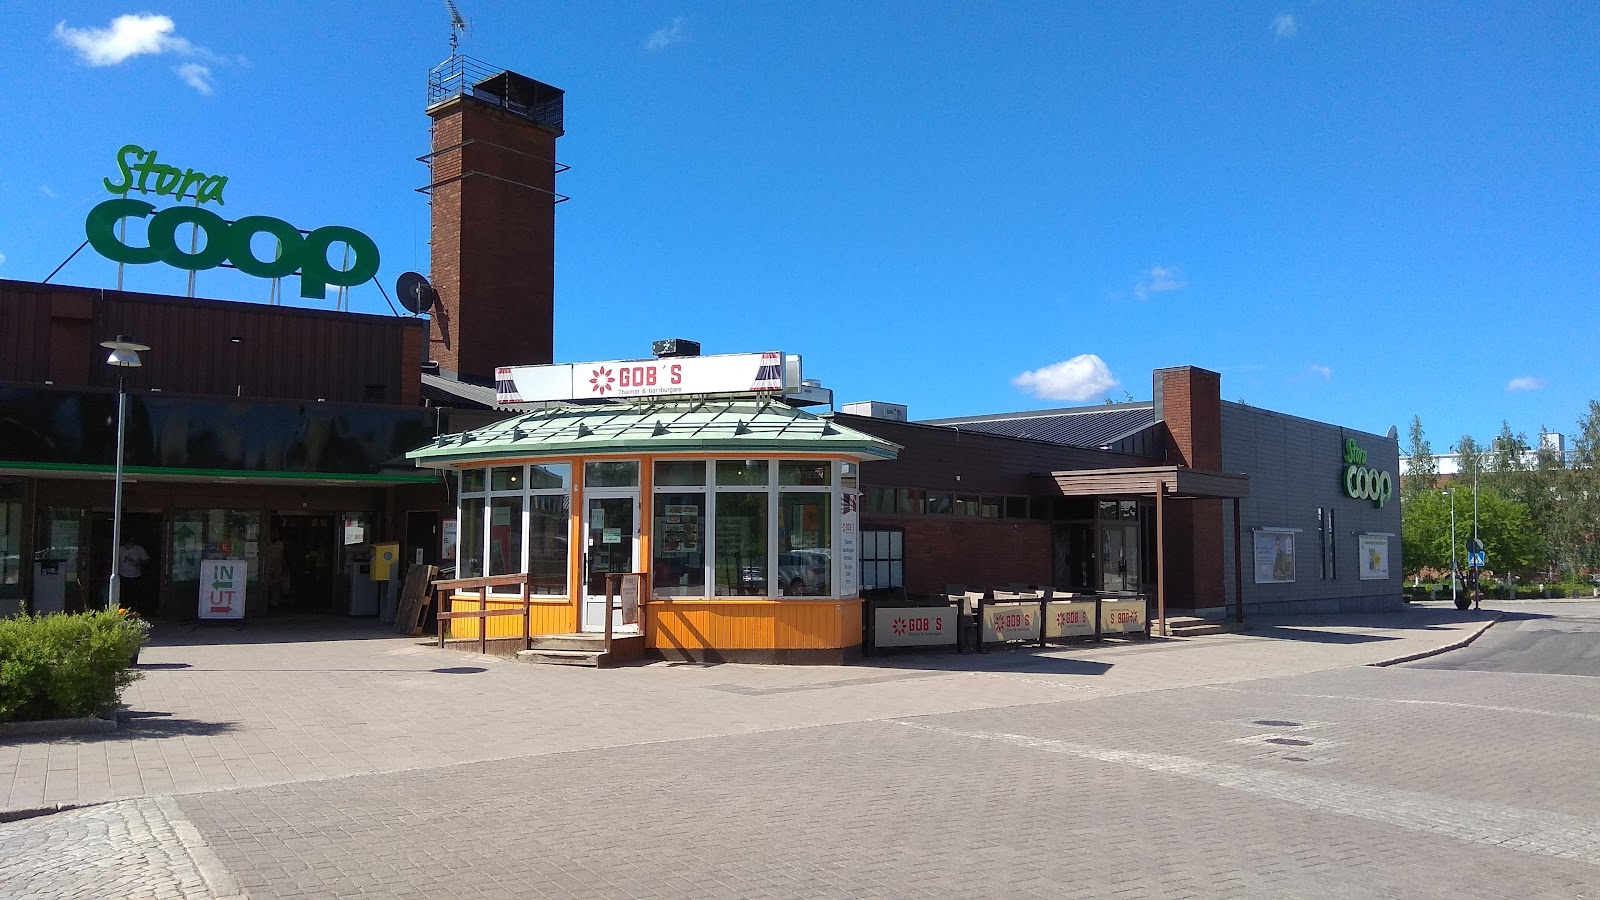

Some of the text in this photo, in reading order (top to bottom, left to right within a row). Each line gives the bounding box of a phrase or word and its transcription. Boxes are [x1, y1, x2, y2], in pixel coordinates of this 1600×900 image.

[103, 144, 229, 206] Stora
[85, 198, 381, 299] coop
[1344, 437, 1368, 465] Stora
[1344, 465, 1392, 509] coop
[213, 565, 234, 580] IN
[210, 590, 237, 605] UT
